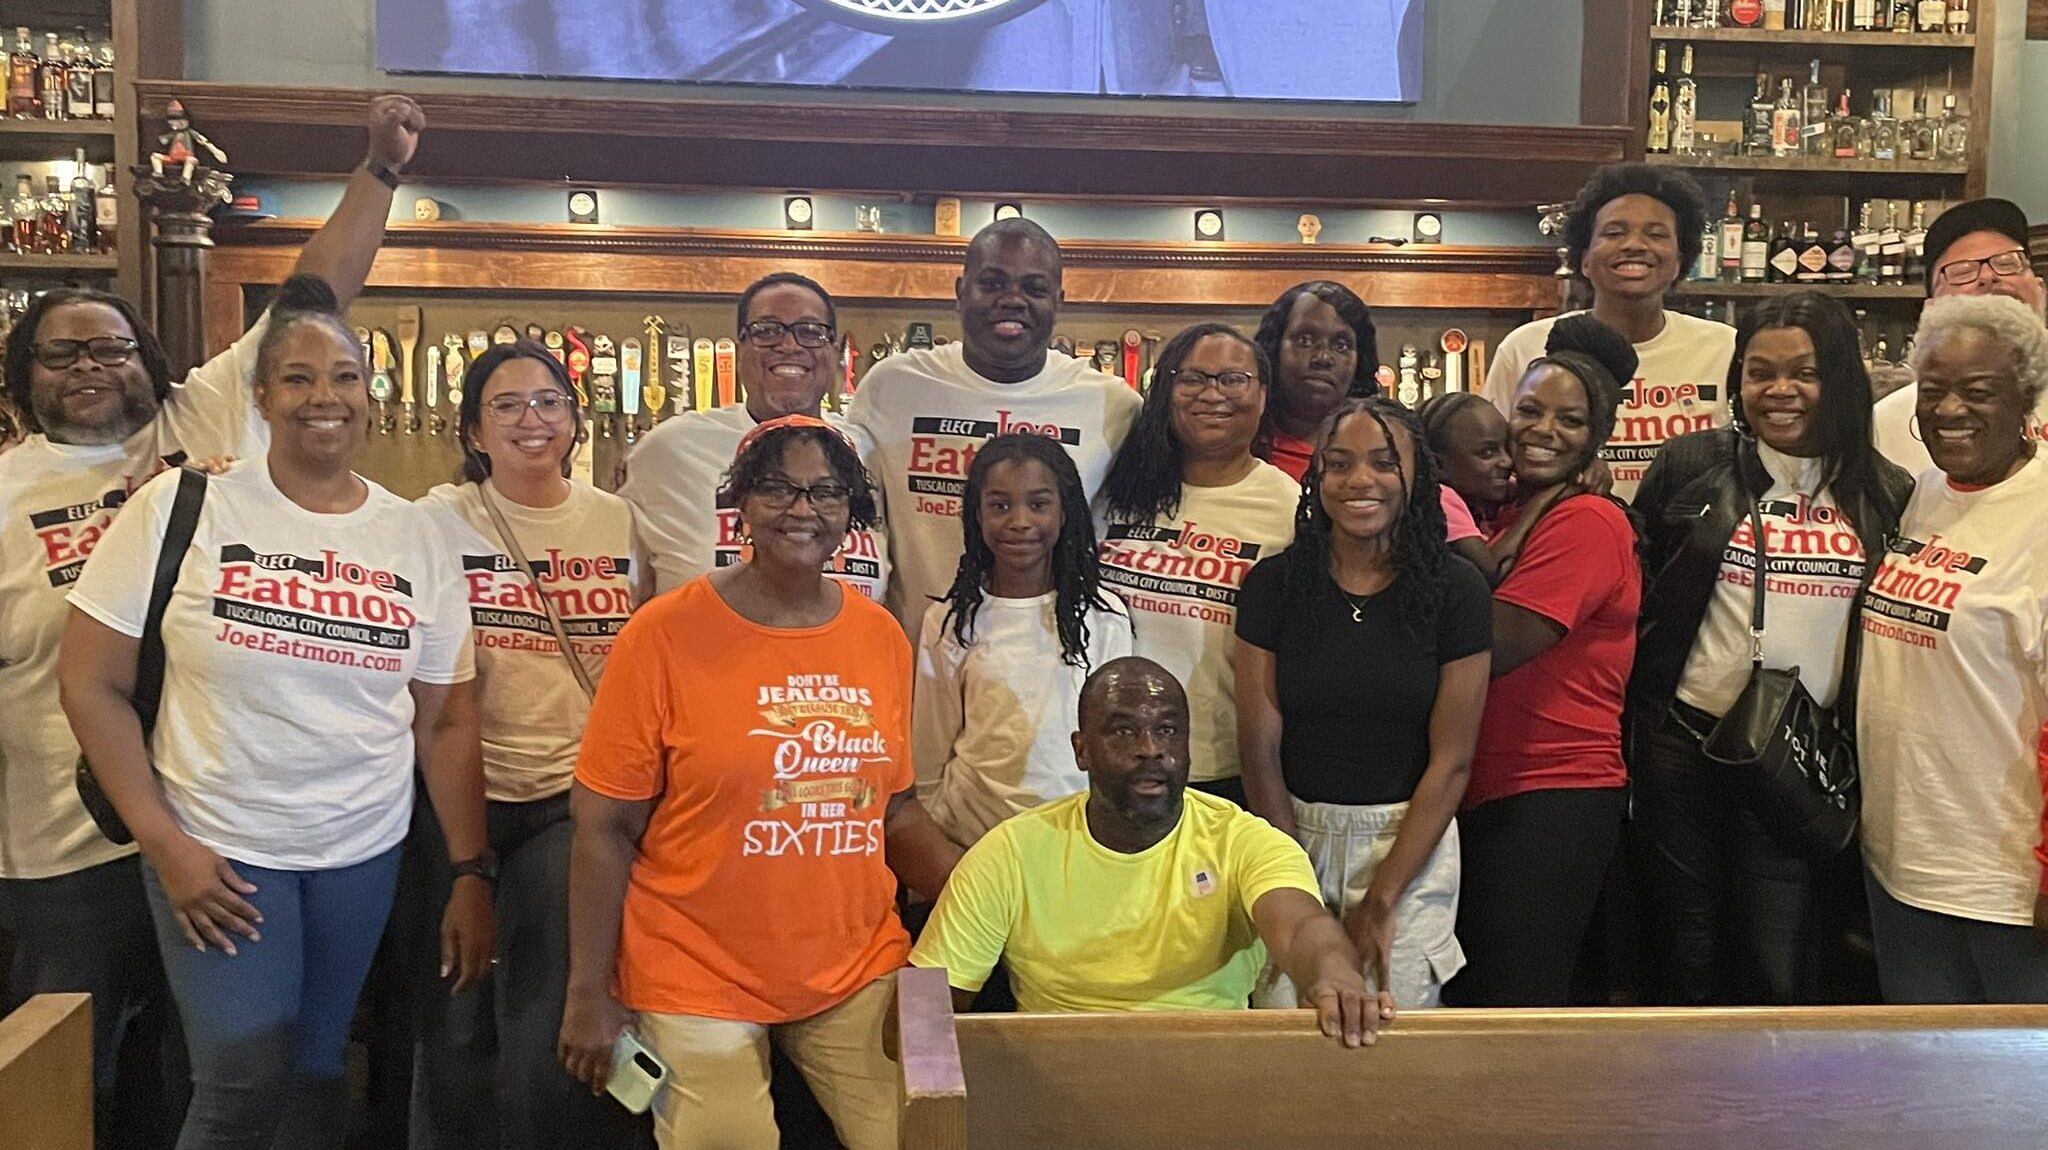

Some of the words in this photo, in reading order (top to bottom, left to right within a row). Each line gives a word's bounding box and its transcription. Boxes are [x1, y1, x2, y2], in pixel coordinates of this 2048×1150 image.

[1625, 377, 1697, 410] Joe
[939, 418, 976, 435] ELECT
[1617, 448, 1637, 460] CITY
[1127, 526, 1161, 540] ELECT
[1167, 520, 1242, 560] Joe
[1909, 534, 1969, 574] Joe
[253, 553, 298, 570] ELECT
[309, 549, 397, 593] Joe
[540, 548, 616, 584] Joe
[1770, 560, 1796, 573] CITY
[1796, 560, 1841, 575] COUNCIL
[212, 565, 417, 629] Eatmon
[1139, 577, 1160, 591] CITY
[1159, 579, 1198, 596] COUNCIL
[1205, 587, 1228, 601] DIST
[225, 603, 299, 630] TUSCALOOSA
[299, 617, 326, 636] CITY
[325, 623, 372, 643] COUNCIL
[379, 630, 400, 647] DIST
[215, 623, 402, 673] JoeEatmon.com
[757, 685, 873, 706] JEALOUS
[823, 674, 841, 687] BE
[766, 720, 887, 754] Black
[773, 739, 866, 779] Queen
[801, 802, 817, 818] IN
[820, 802, 846, 818] HER
[743, 818, 883, 857] SIXTIES
